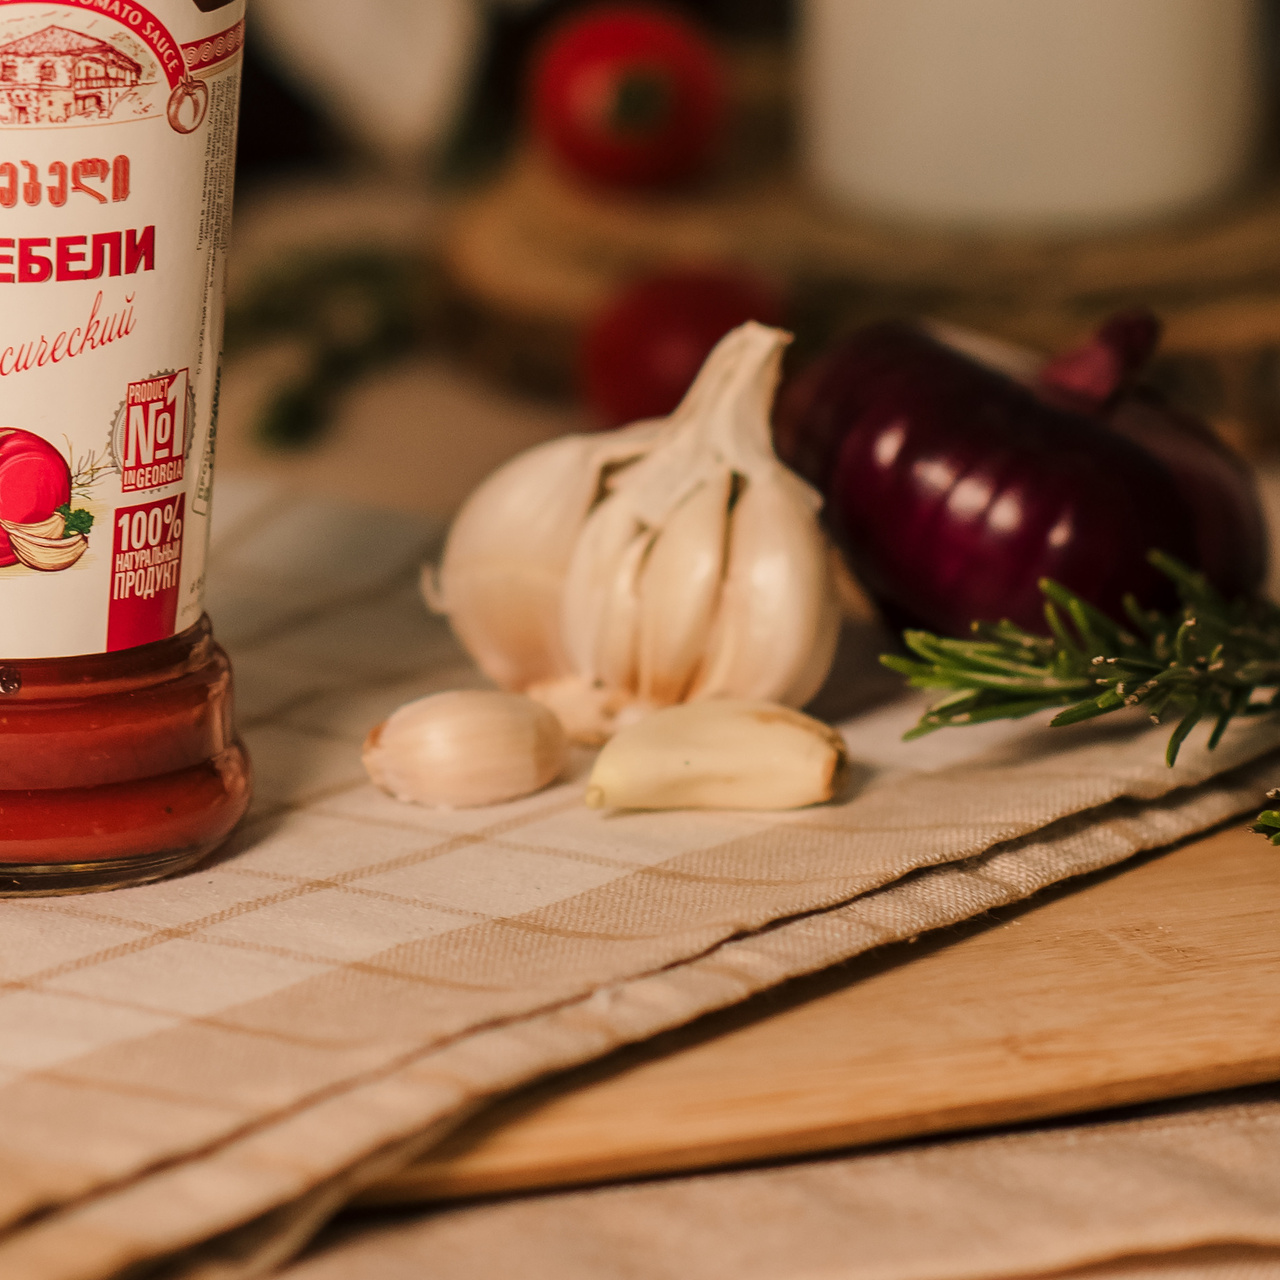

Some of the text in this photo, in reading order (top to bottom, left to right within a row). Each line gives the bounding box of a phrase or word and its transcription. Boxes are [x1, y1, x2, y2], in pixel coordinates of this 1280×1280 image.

[141, 21, 180, 73] SAUCE
[128, 378, 170, 404] PRODUCT
[124, 469, 136, 490] IN
[136, 459, 183, 488] GEORGIA
[117, 492, 182, 552] 100%
[113, 558, 180, 601] ПРОДУКТ
